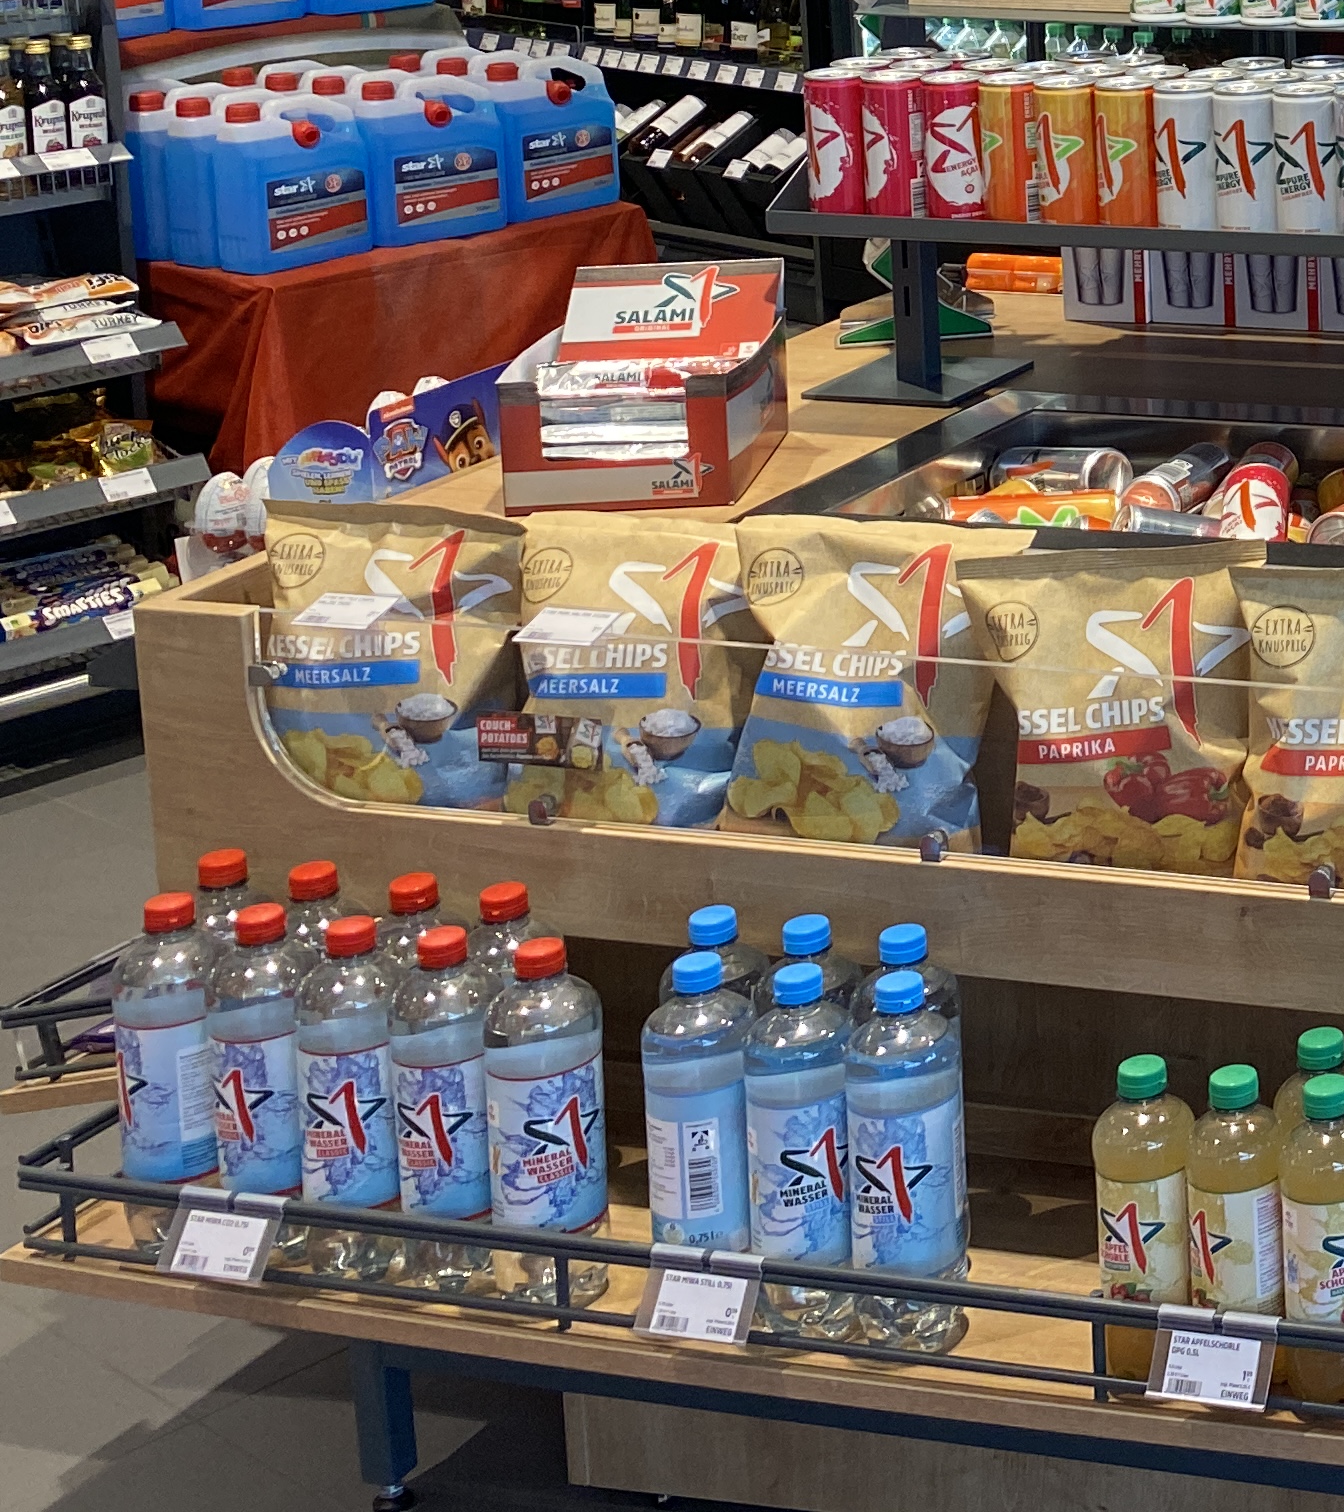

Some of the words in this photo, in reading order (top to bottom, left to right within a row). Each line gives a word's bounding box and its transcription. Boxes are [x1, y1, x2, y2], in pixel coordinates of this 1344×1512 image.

[528, 136, 551, 150] star
[401, 159, 425, 172] star
[945, 158, 977, 173] ENERGY
[1285, 173, 1310, 185] PURE
[274, 183, 297, 197] star
[1279, 183, 1313, 194] ENERGY
[91, 313, 139, 330] TURKEY
[614, 307, 695, 324] SALAMI
[634, 324, 671, 332] ORIGINAL
[594, 371, 641, 382] SALAMI
[389, 455, 419, 473] PATROL
[651, 479, 694, 489] SALAMI
[279, 545, 314, 560] EXTRA
[531, 560, 561, 575] EXTRA
[757, 560, 791, 578] EXTRA
[42, 587, 125, 622] SMARTIES
[1265, 618, 1300, 635] EXTRA
[339, 631, 421, 657] CHIPS
[1257, 637, 1307, 654] KNUSPRIG
[593, 644, 667, 668] CHIPS
[833, 649, 907, 677] CHIPS
[294, 666, 371, 684] MEERSALZ
[537, 678, 619, 694] MEERSALZ
[773, 677, 860, 703] MEERSALZ
[1085, 696, 1165, 727] CHIPS
[480, 720, 516, 732] COUCH-
[481, 732, 529, 745] POTATOES
[1038, 739, 1116, 759] PAPRIKA
[309, 1139, 348, 1148] WASSER
[522, 1148, 571, 1168] MINERAL
[526, 1157, 574, 1176] WASSER
[537, 1167, 574, 1183] CLASSIC
[780, 1180, 827, 1197] MINERAL
[783, 1189, 829, 1207] WASSER
[858, 1204, 894, 1214] WASSER
[665, 1274, 681, 1283] STAR
[700, 1278, 715, 1287] STILL
[706, 1325, 732, 1337] EINWEG
[1173, 1335, 1190, 1345] STAR
[1190, 1337, 1241, 1352] APFELSCHORLE
[1220, 1389, 1249, 1401] EINWEG
